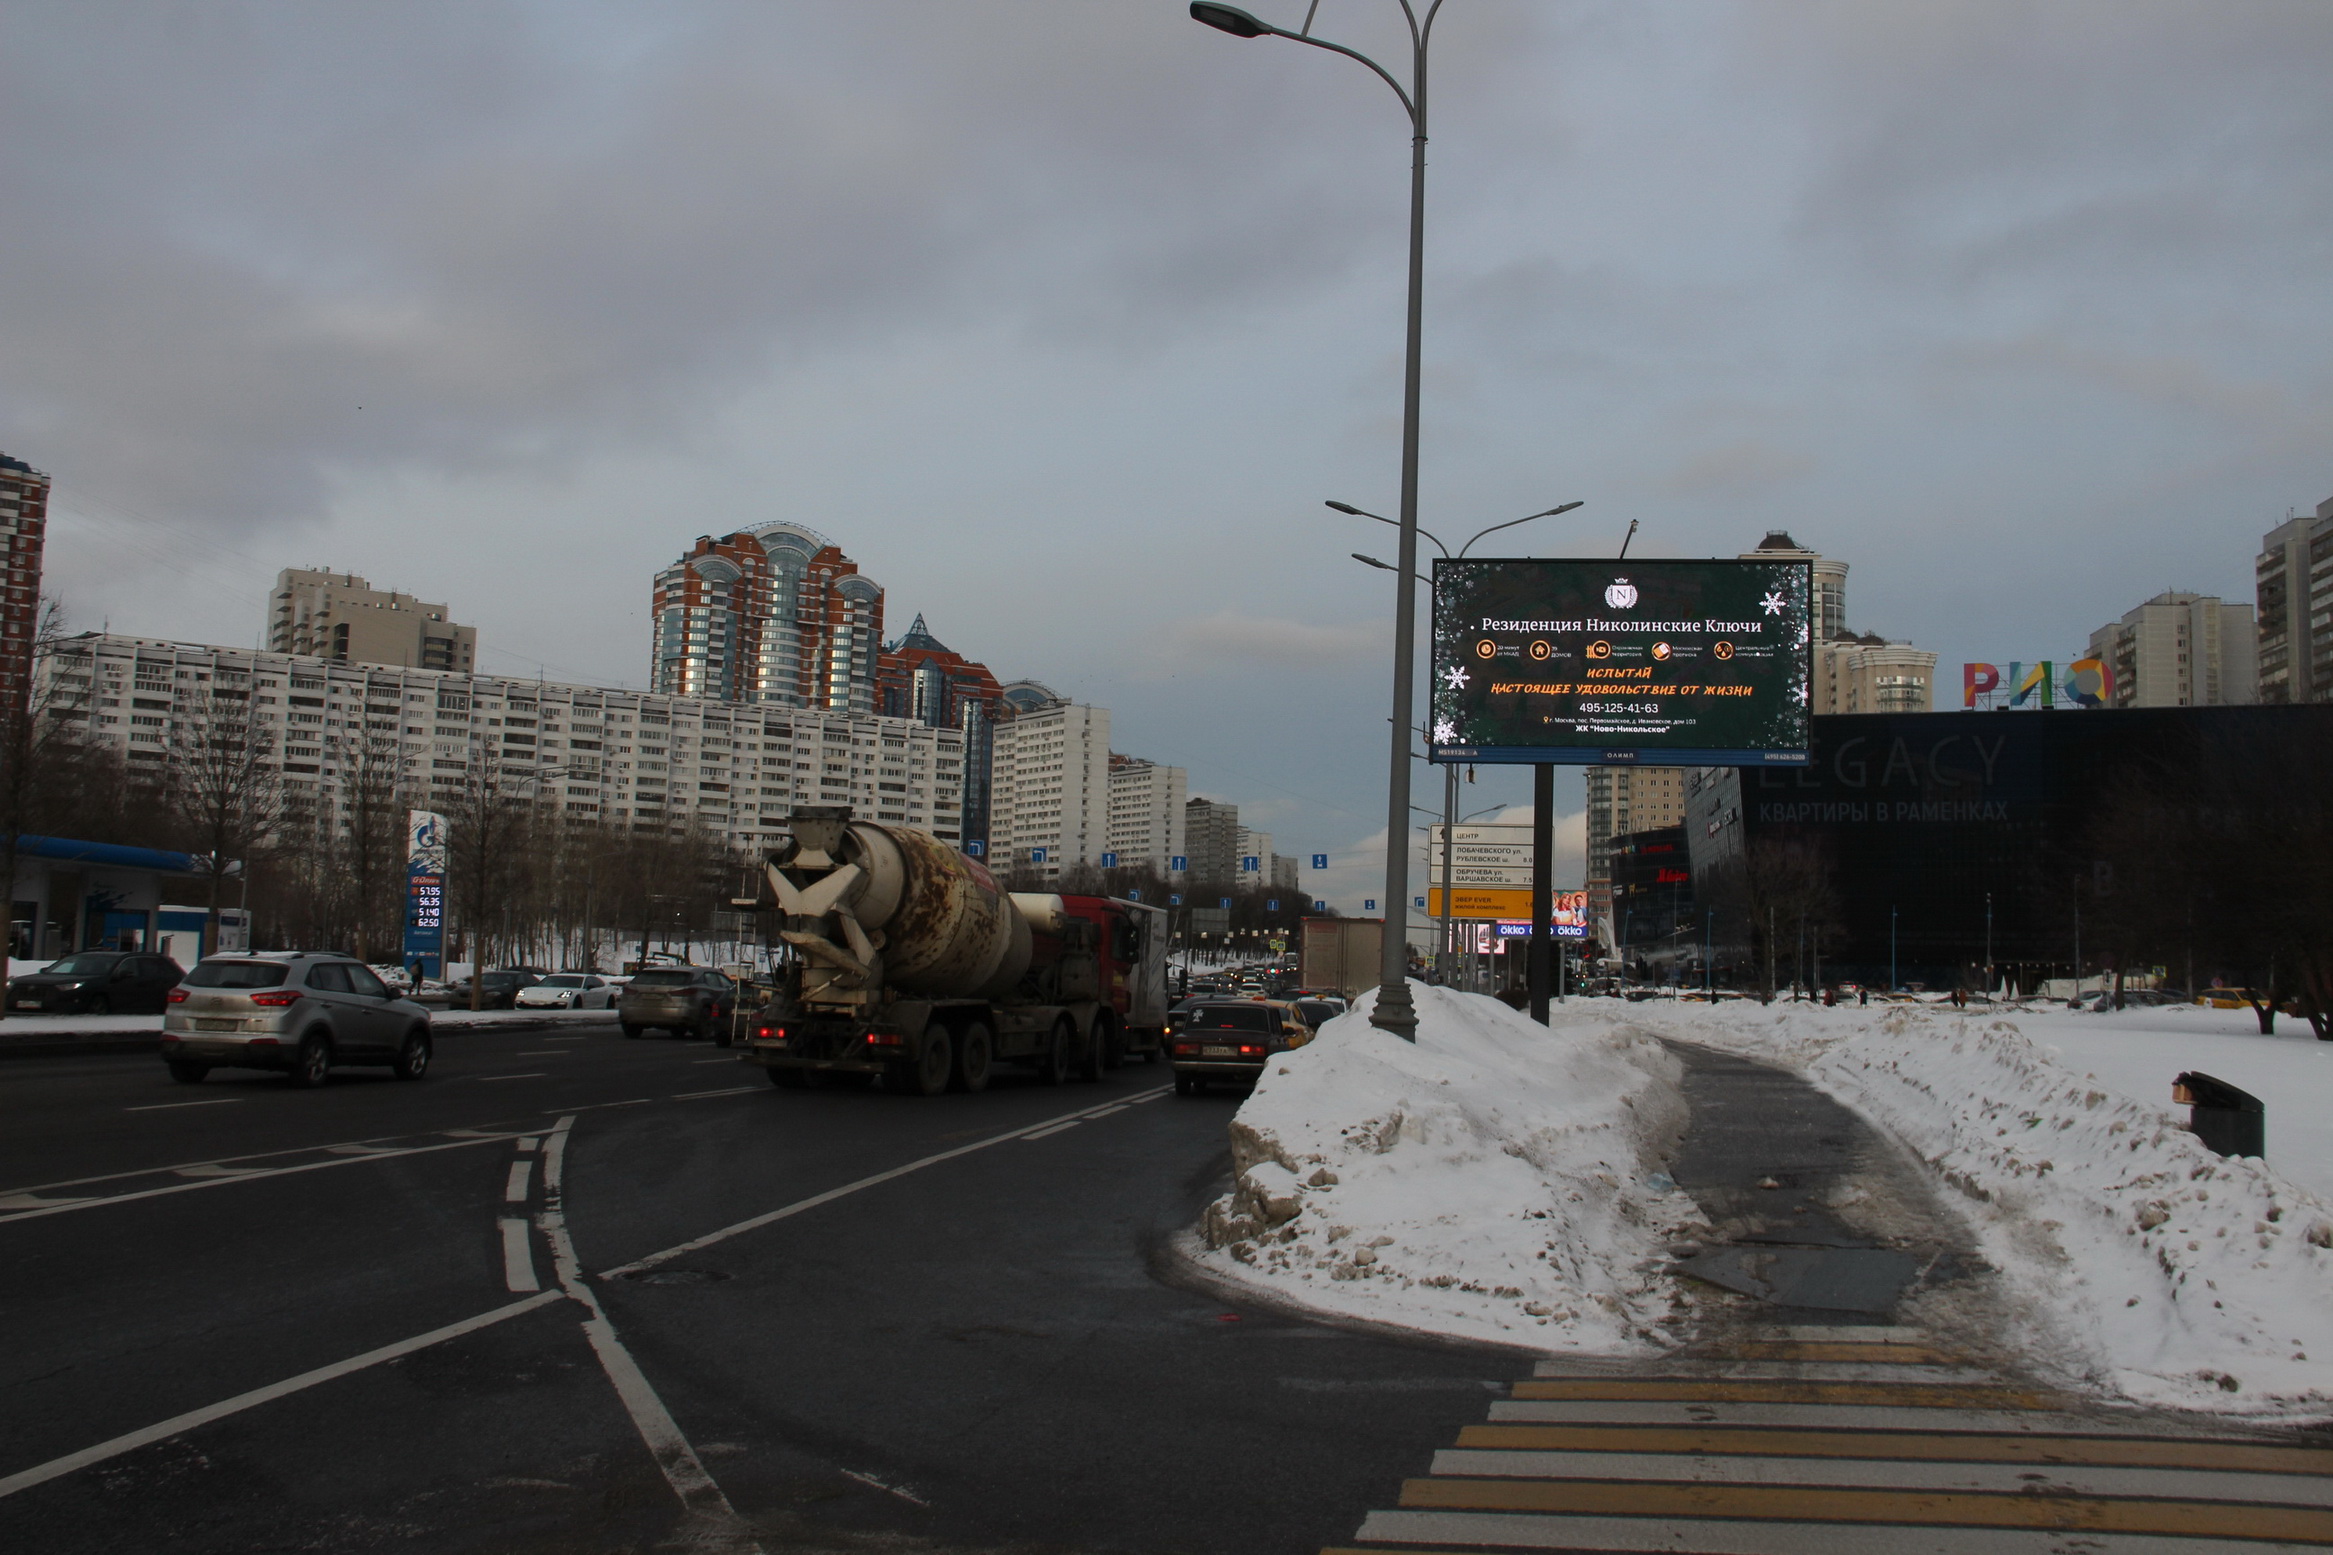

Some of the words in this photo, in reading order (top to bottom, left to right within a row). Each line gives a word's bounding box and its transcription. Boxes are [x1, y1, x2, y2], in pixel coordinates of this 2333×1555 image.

[1481, 617, 1582, 634] Резиденция
[1586, 618, 1701, 633] Николинские
[1705, 619, 1762, 633] Ключи
[1586, 666, 1653, 679] ИСПЫТАЙ
[1964, 658, 2114, 707] РИО
[1490, 683, 1572, 695] НАСТОЯЩЕЕ
[1575, 684, 1678, 696] УДОВОЛЬСТВИЕ
[1680, 685, 1700, 696] ОТ
[1703, 685, 1754, 697] ЖИЗНИ
[1579, 702, 1659, 714] 495-125-41-63
[1760, 801, 1868, 823] КВАРТИРЫ
[1876, 801, 1889, 822] В
[1896, 800, 2008, 822] РАМЕНКАХ
[420, 897, 440, 906] 56.35
[418, 918, 439, 927] 62.50
